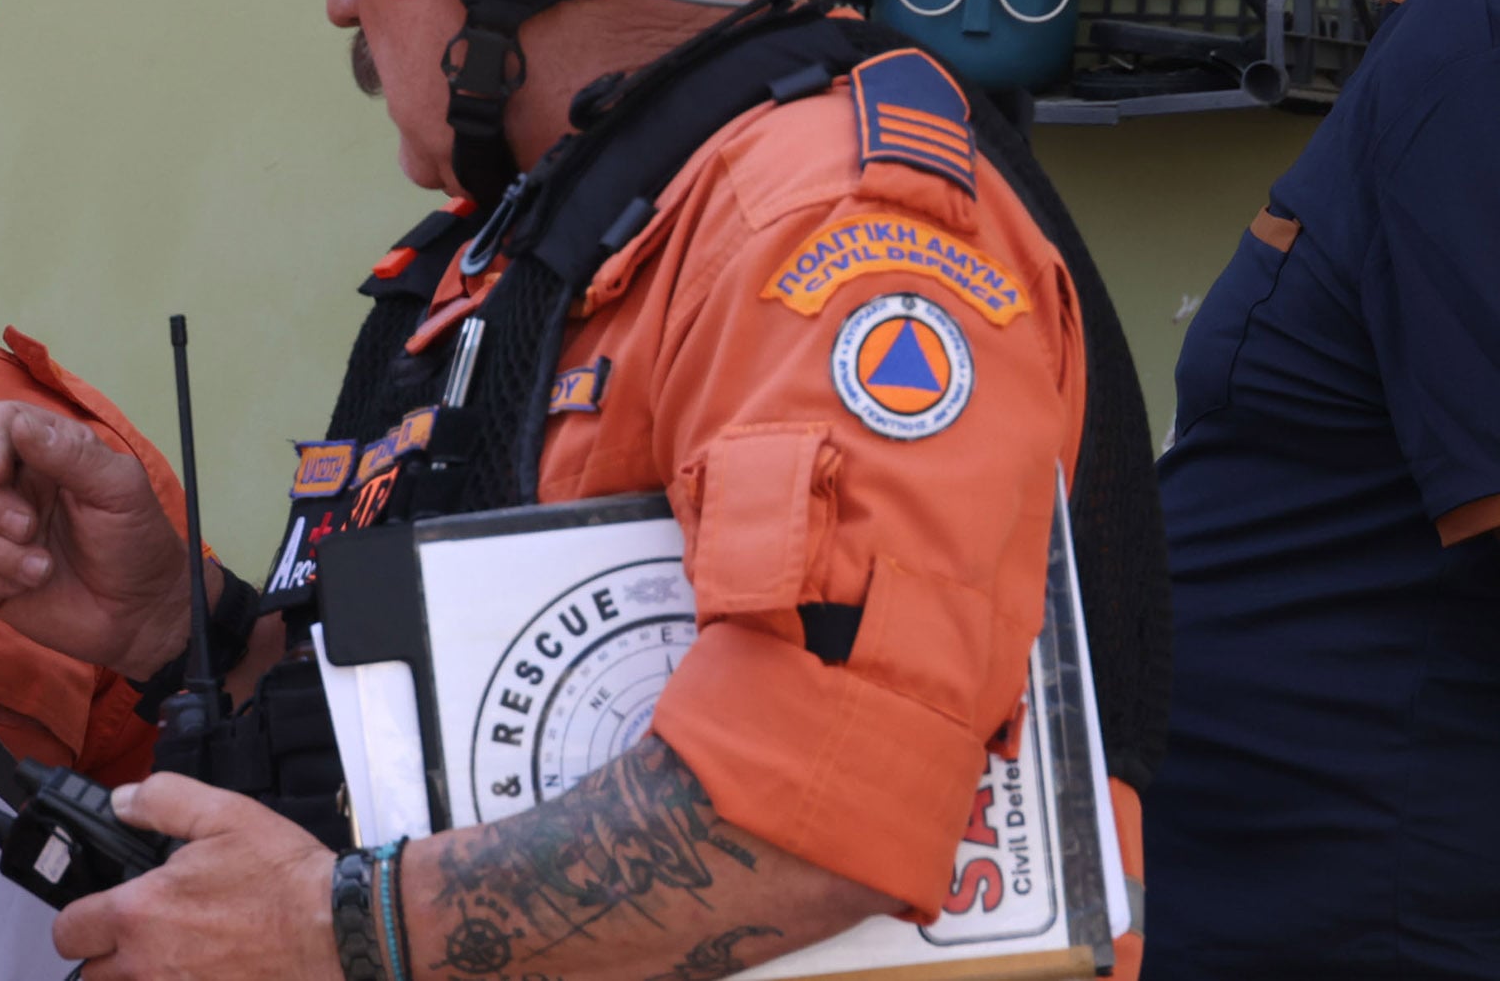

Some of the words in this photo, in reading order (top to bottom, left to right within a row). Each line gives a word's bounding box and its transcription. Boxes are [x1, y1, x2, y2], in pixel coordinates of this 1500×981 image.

[776, 222, 918, 296] ΠΟΛΙΤΙΚΗ
[926, 237, 1019, 307] ΑΜΥΝΑ
[804, 246, 880, 293] CIVIL
[886, 246, 1006, 312] DEFENCE
[491, 588, 620, 747] RESCUE
[660, 625, 674, 644] E
[491, 774, 522, 798] &
[941, 754, 1005, 915] SA
[1008, 834, 1032, 897] Civil
